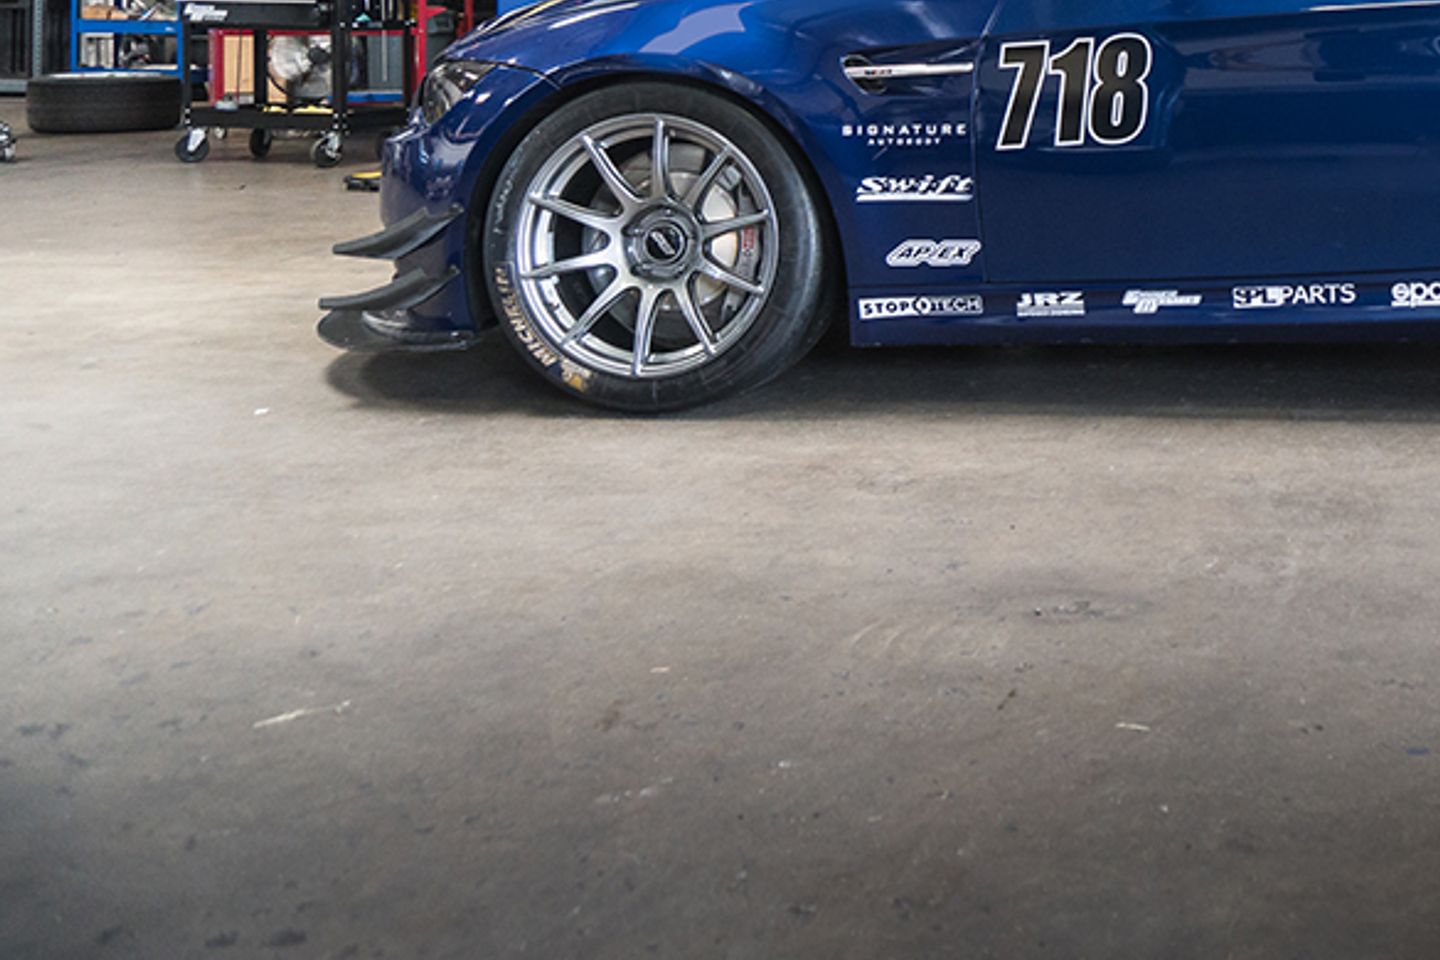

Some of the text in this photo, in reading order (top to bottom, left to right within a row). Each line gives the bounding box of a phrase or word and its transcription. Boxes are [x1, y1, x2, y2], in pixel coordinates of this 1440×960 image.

[996, 32, 1153, 149] 718
[841, 122, 967, 137] SIGNATURE
[856, 174, 976, 195] Swift
[1016, 291, 1083, 307] JRZ
